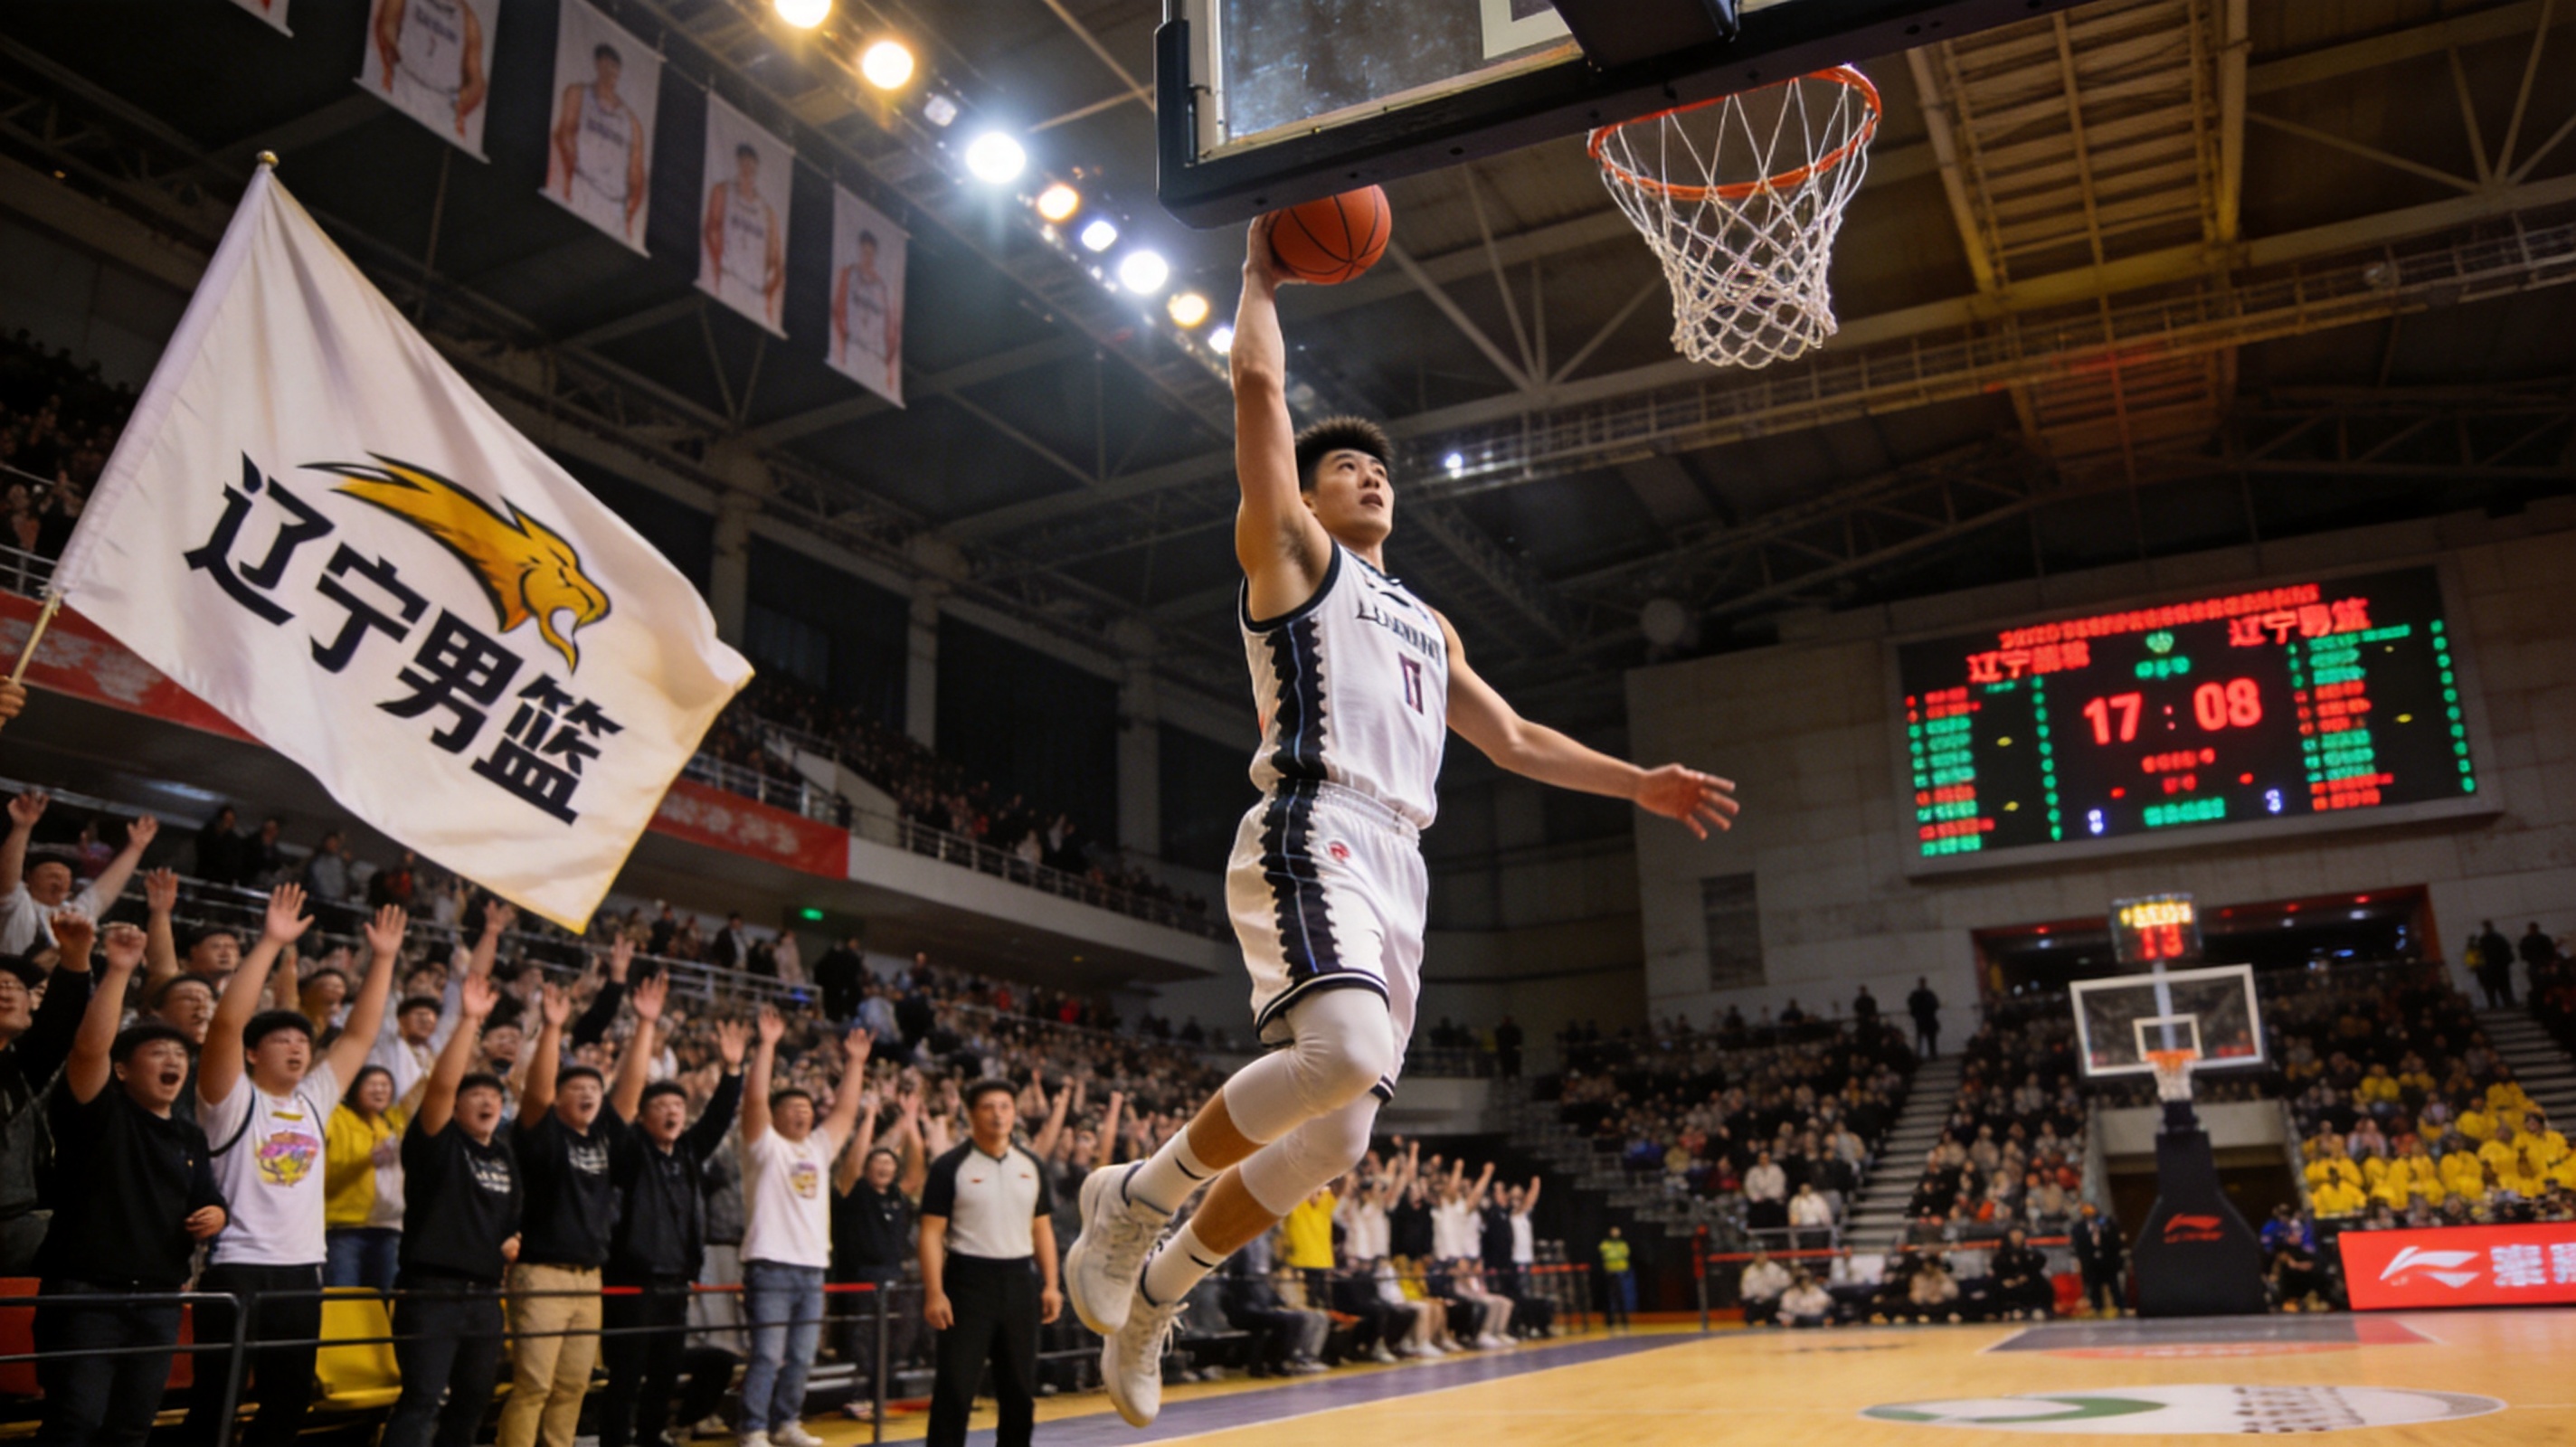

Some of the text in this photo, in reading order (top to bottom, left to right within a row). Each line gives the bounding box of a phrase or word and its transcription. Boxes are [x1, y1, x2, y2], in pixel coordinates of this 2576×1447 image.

[184, 450, 625, 827] 辽宁男篮
[2084, 691, 2143, 745] 17
[2192, 676, 2263, 732] 08
